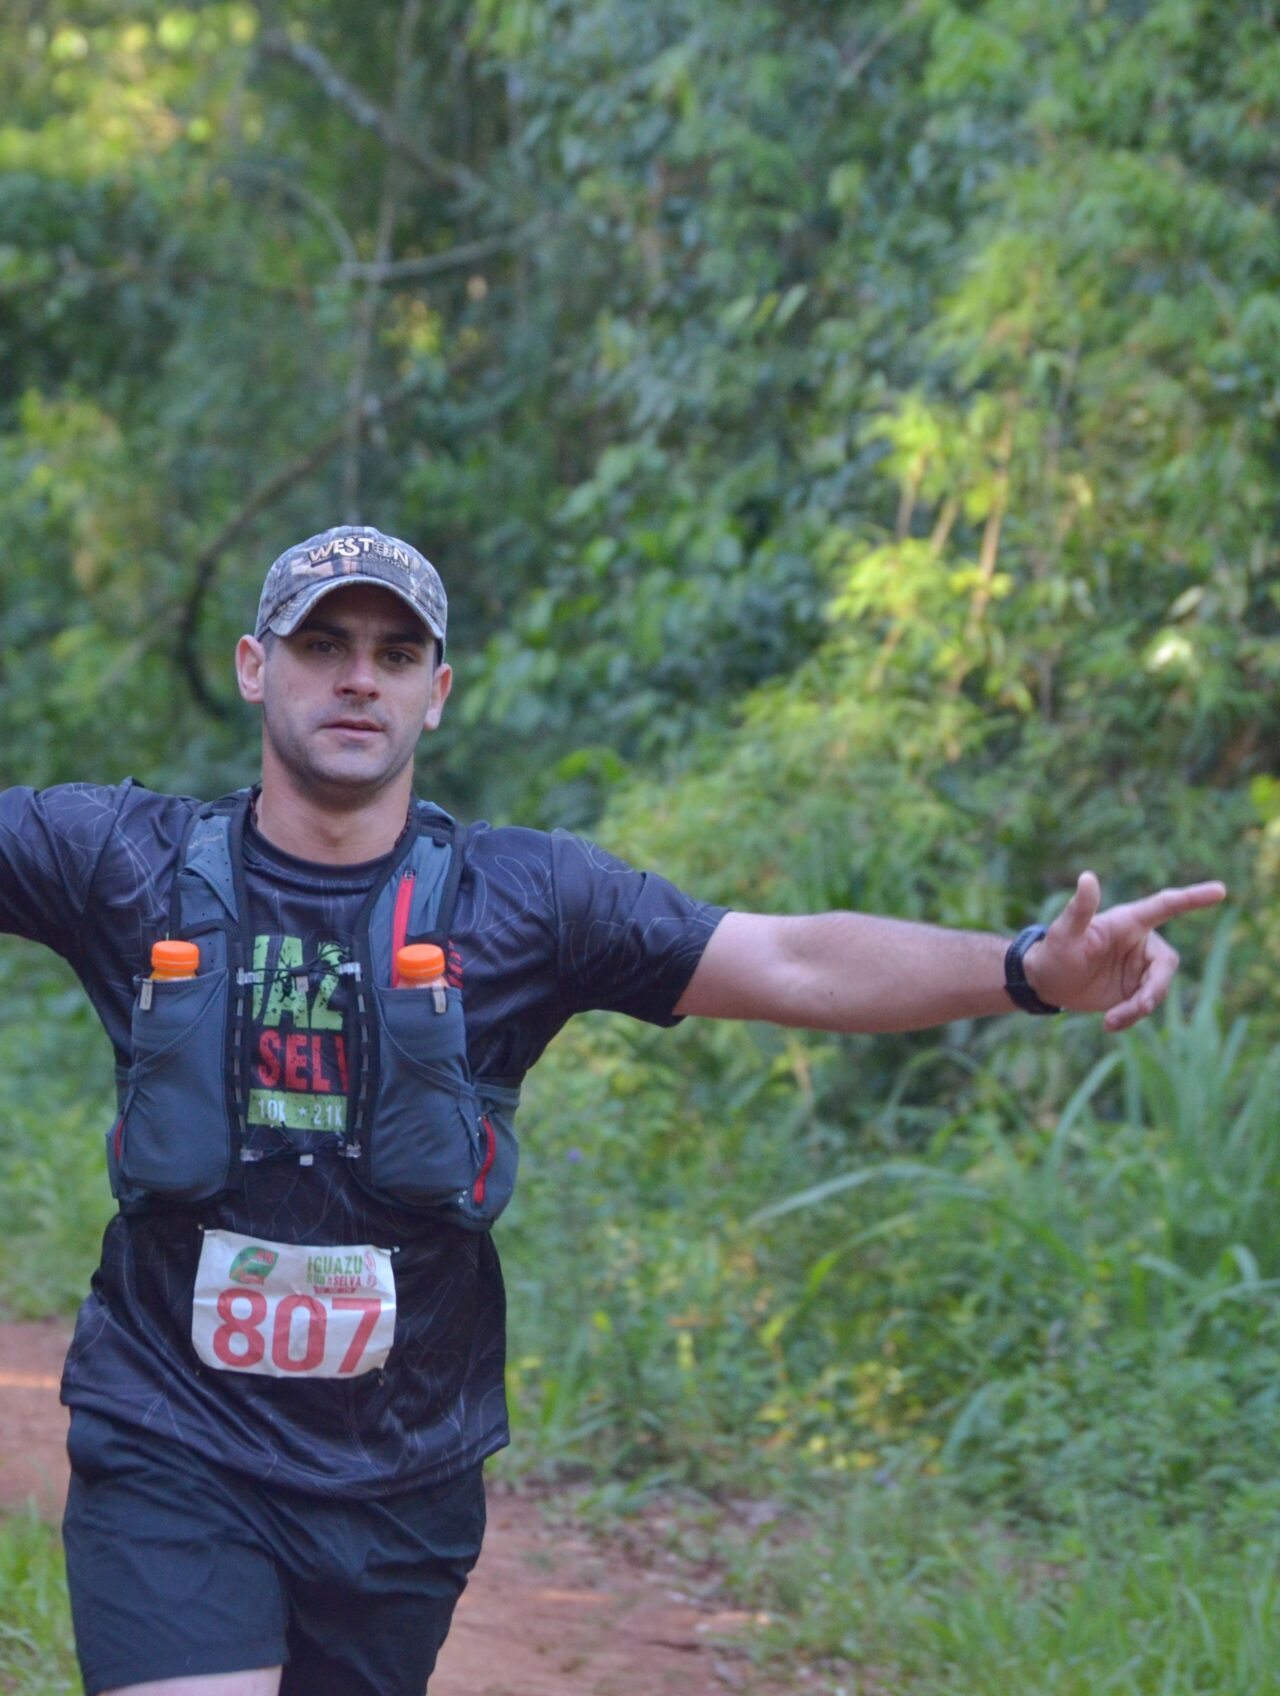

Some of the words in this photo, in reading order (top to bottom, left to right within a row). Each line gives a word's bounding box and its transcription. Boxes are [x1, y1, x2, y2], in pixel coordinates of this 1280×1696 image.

[308, 537, 410, 568] WESTON
[258, 1099, 286, 1122] 10K
[313, 1104, 343, 1126] 21K
[307, 1255, 363, 1274] IGUAZU
[333, 1275, 362, 1287] SELVA
[212, 1287, 382, 1374] 807
